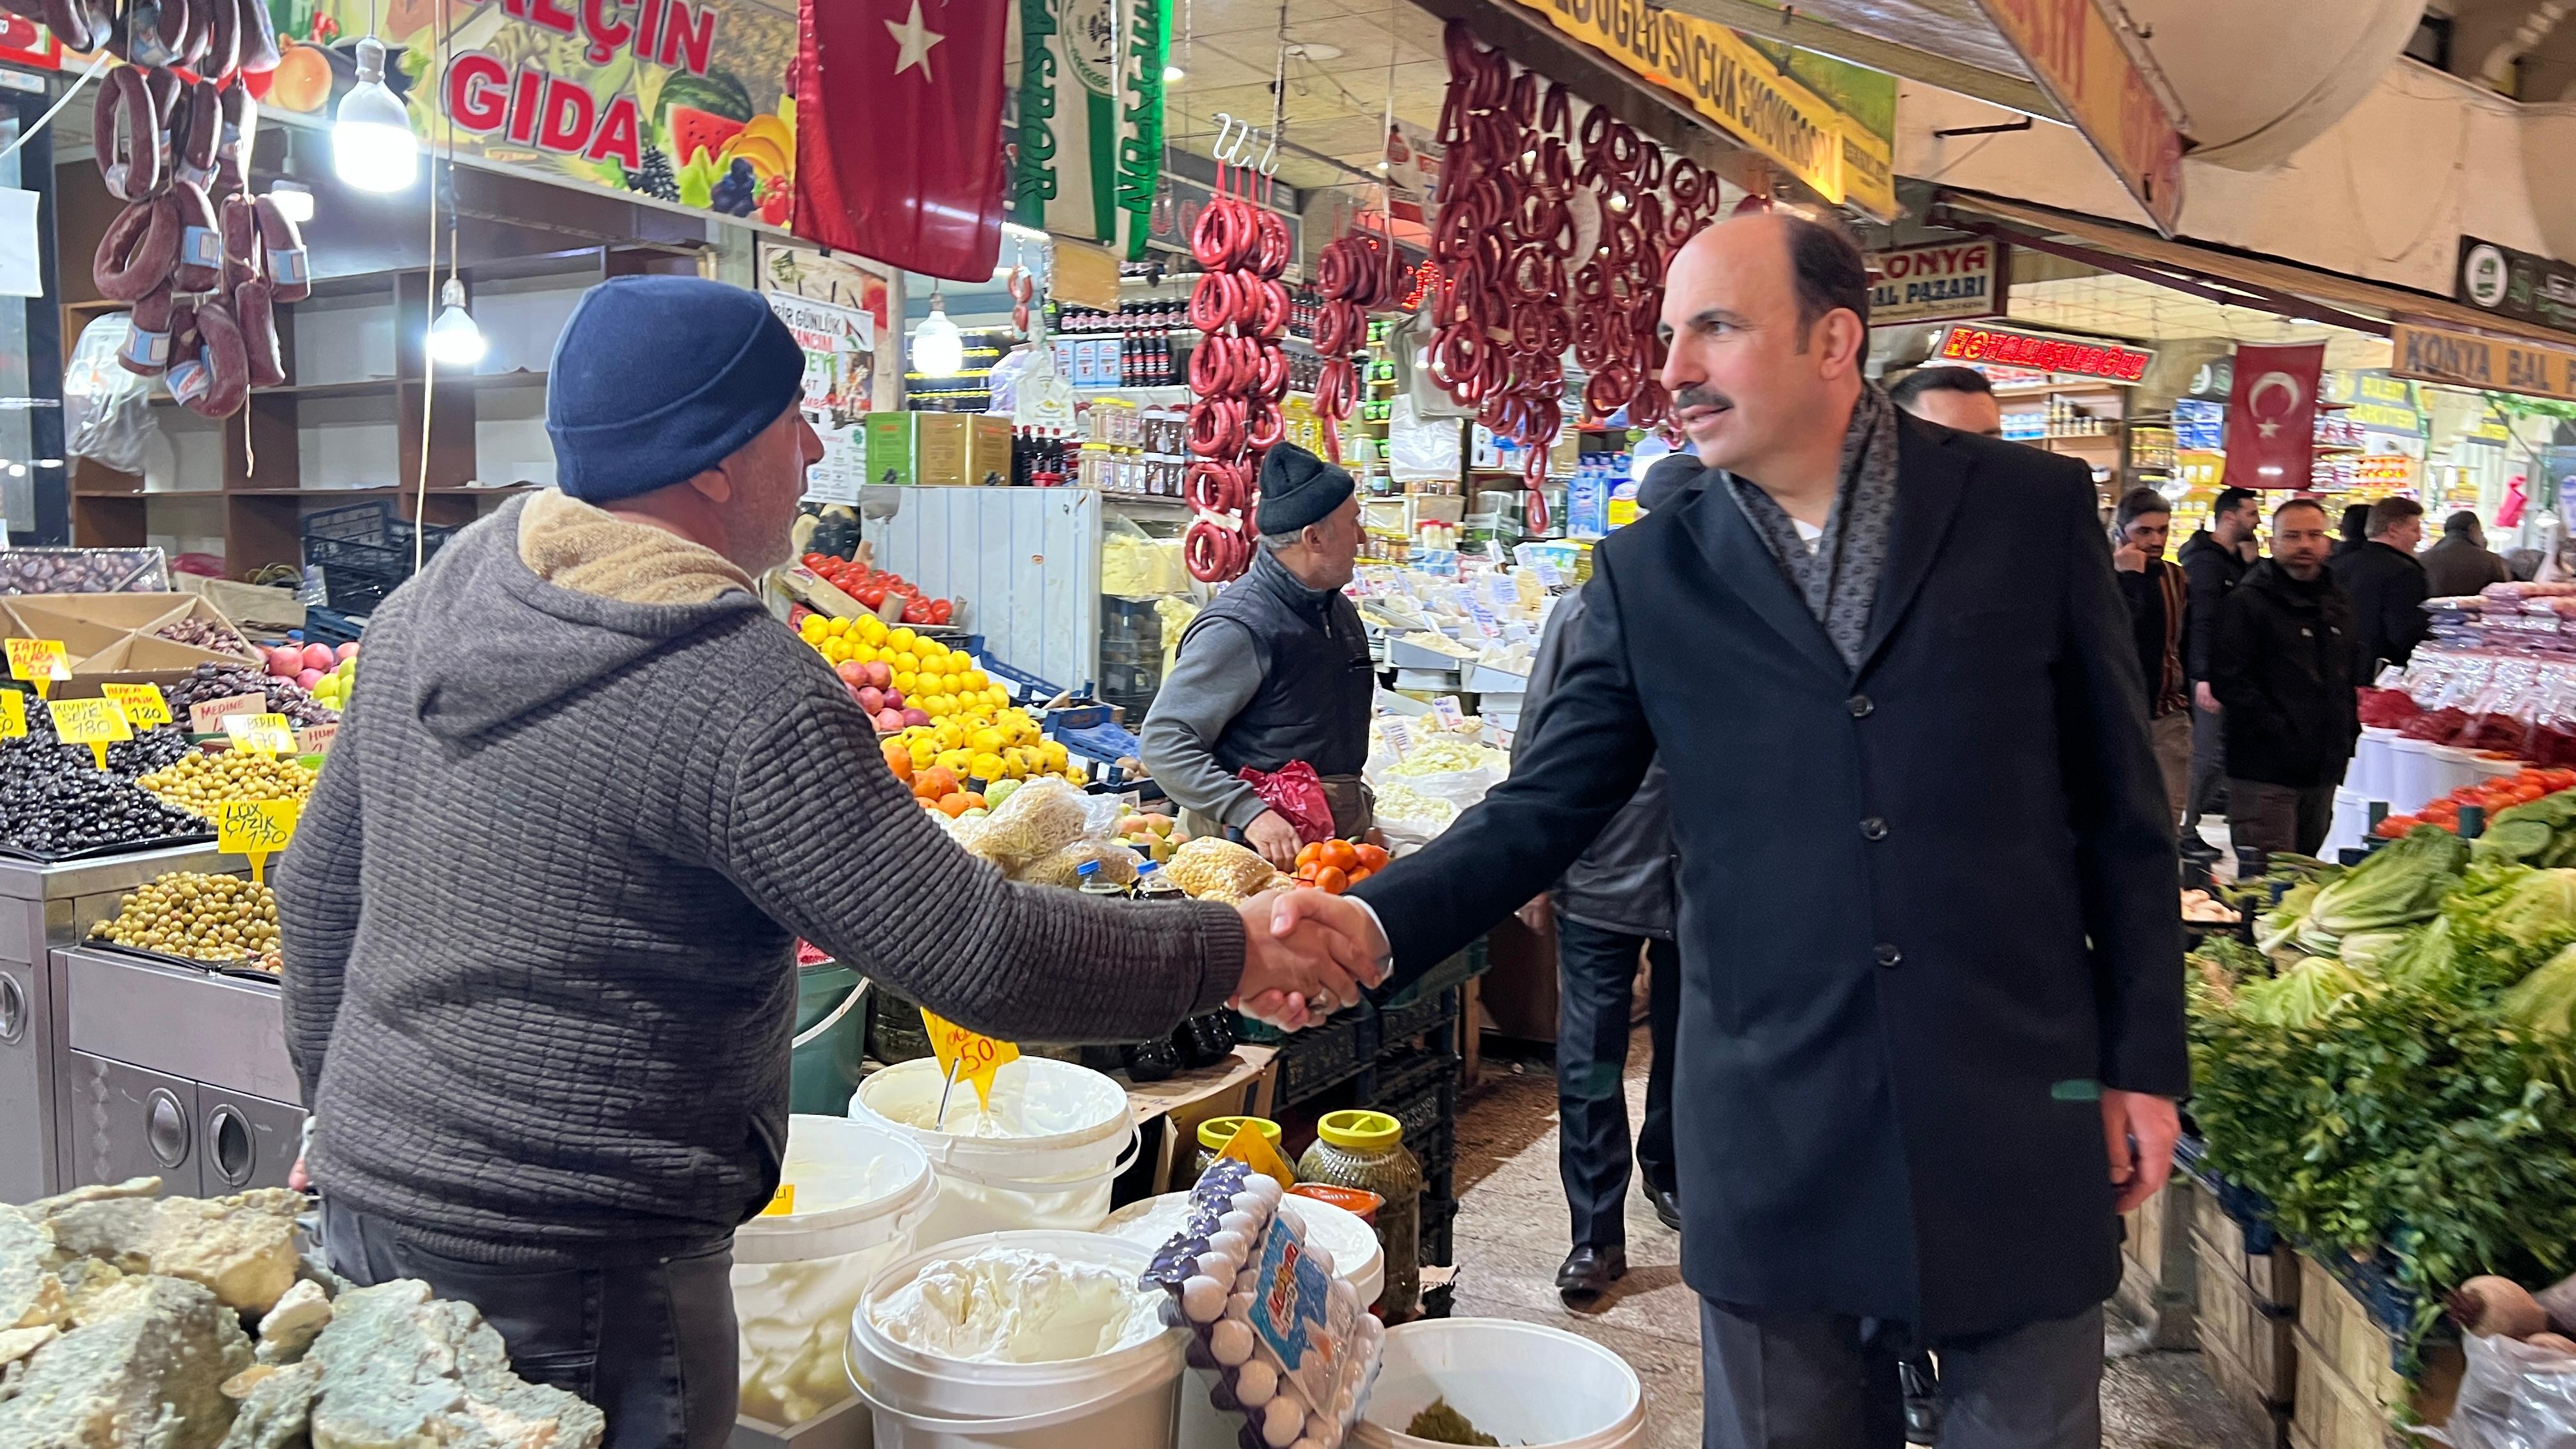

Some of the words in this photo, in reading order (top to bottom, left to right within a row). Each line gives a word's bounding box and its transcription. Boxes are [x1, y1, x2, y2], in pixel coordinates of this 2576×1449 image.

[449, 53, 641, 172] GIDA
[1869, 285, 1900, 307] AL
[1905, 275, 1985, 303] PAZARI
[73, 720, 110, 739] 180
[247, 830, 287, 851] 170
[961, 1038, 995, 1073] 50
